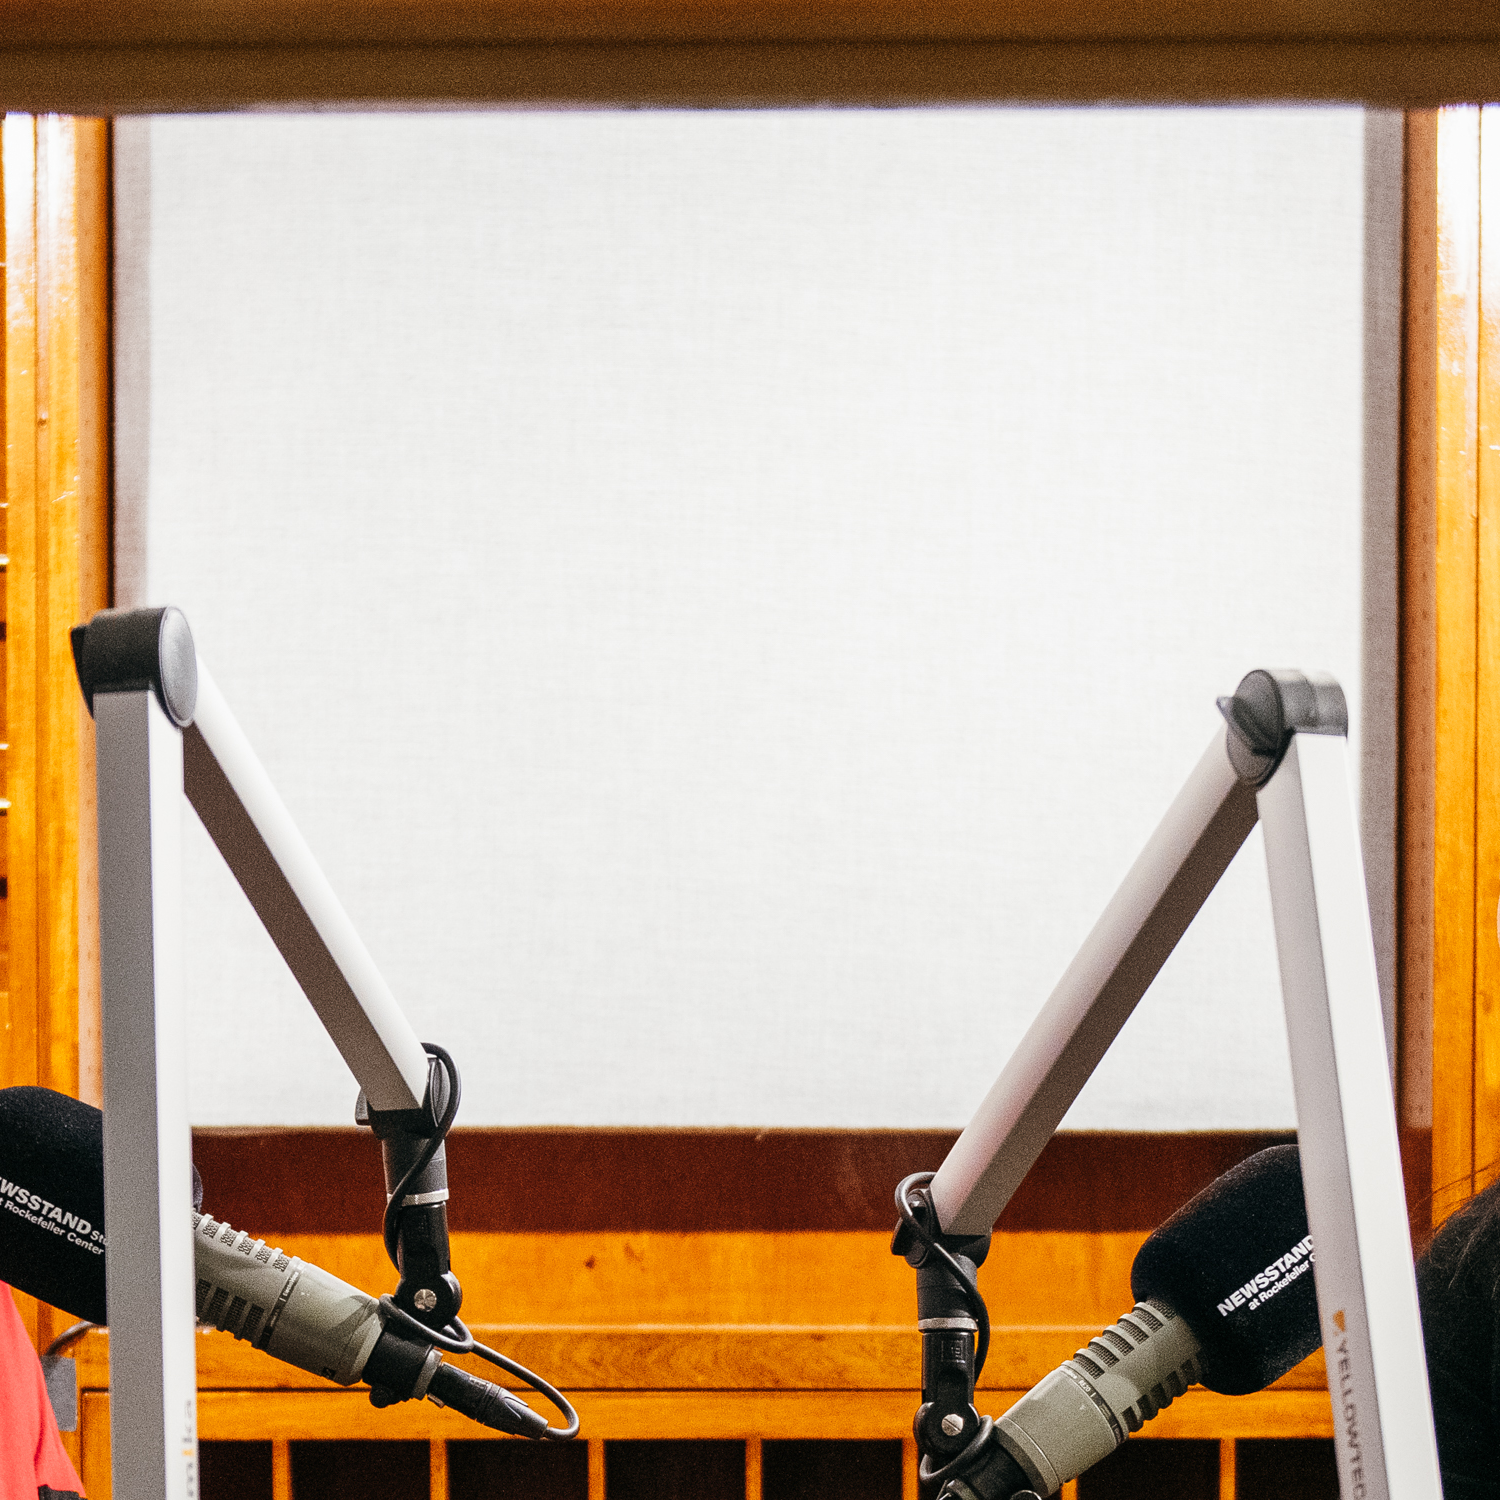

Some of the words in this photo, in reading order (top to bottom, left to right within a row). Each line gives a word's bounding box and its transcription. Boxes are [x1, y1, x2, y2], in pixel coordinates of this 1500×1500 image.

[4, 1200, 66, 1236] Rockefeller
[67, 1232, 105, 1255] Center
[1248, 1298, 1261, 1311] at
[1258, 1260, 1310, 1302] Rockefeller
